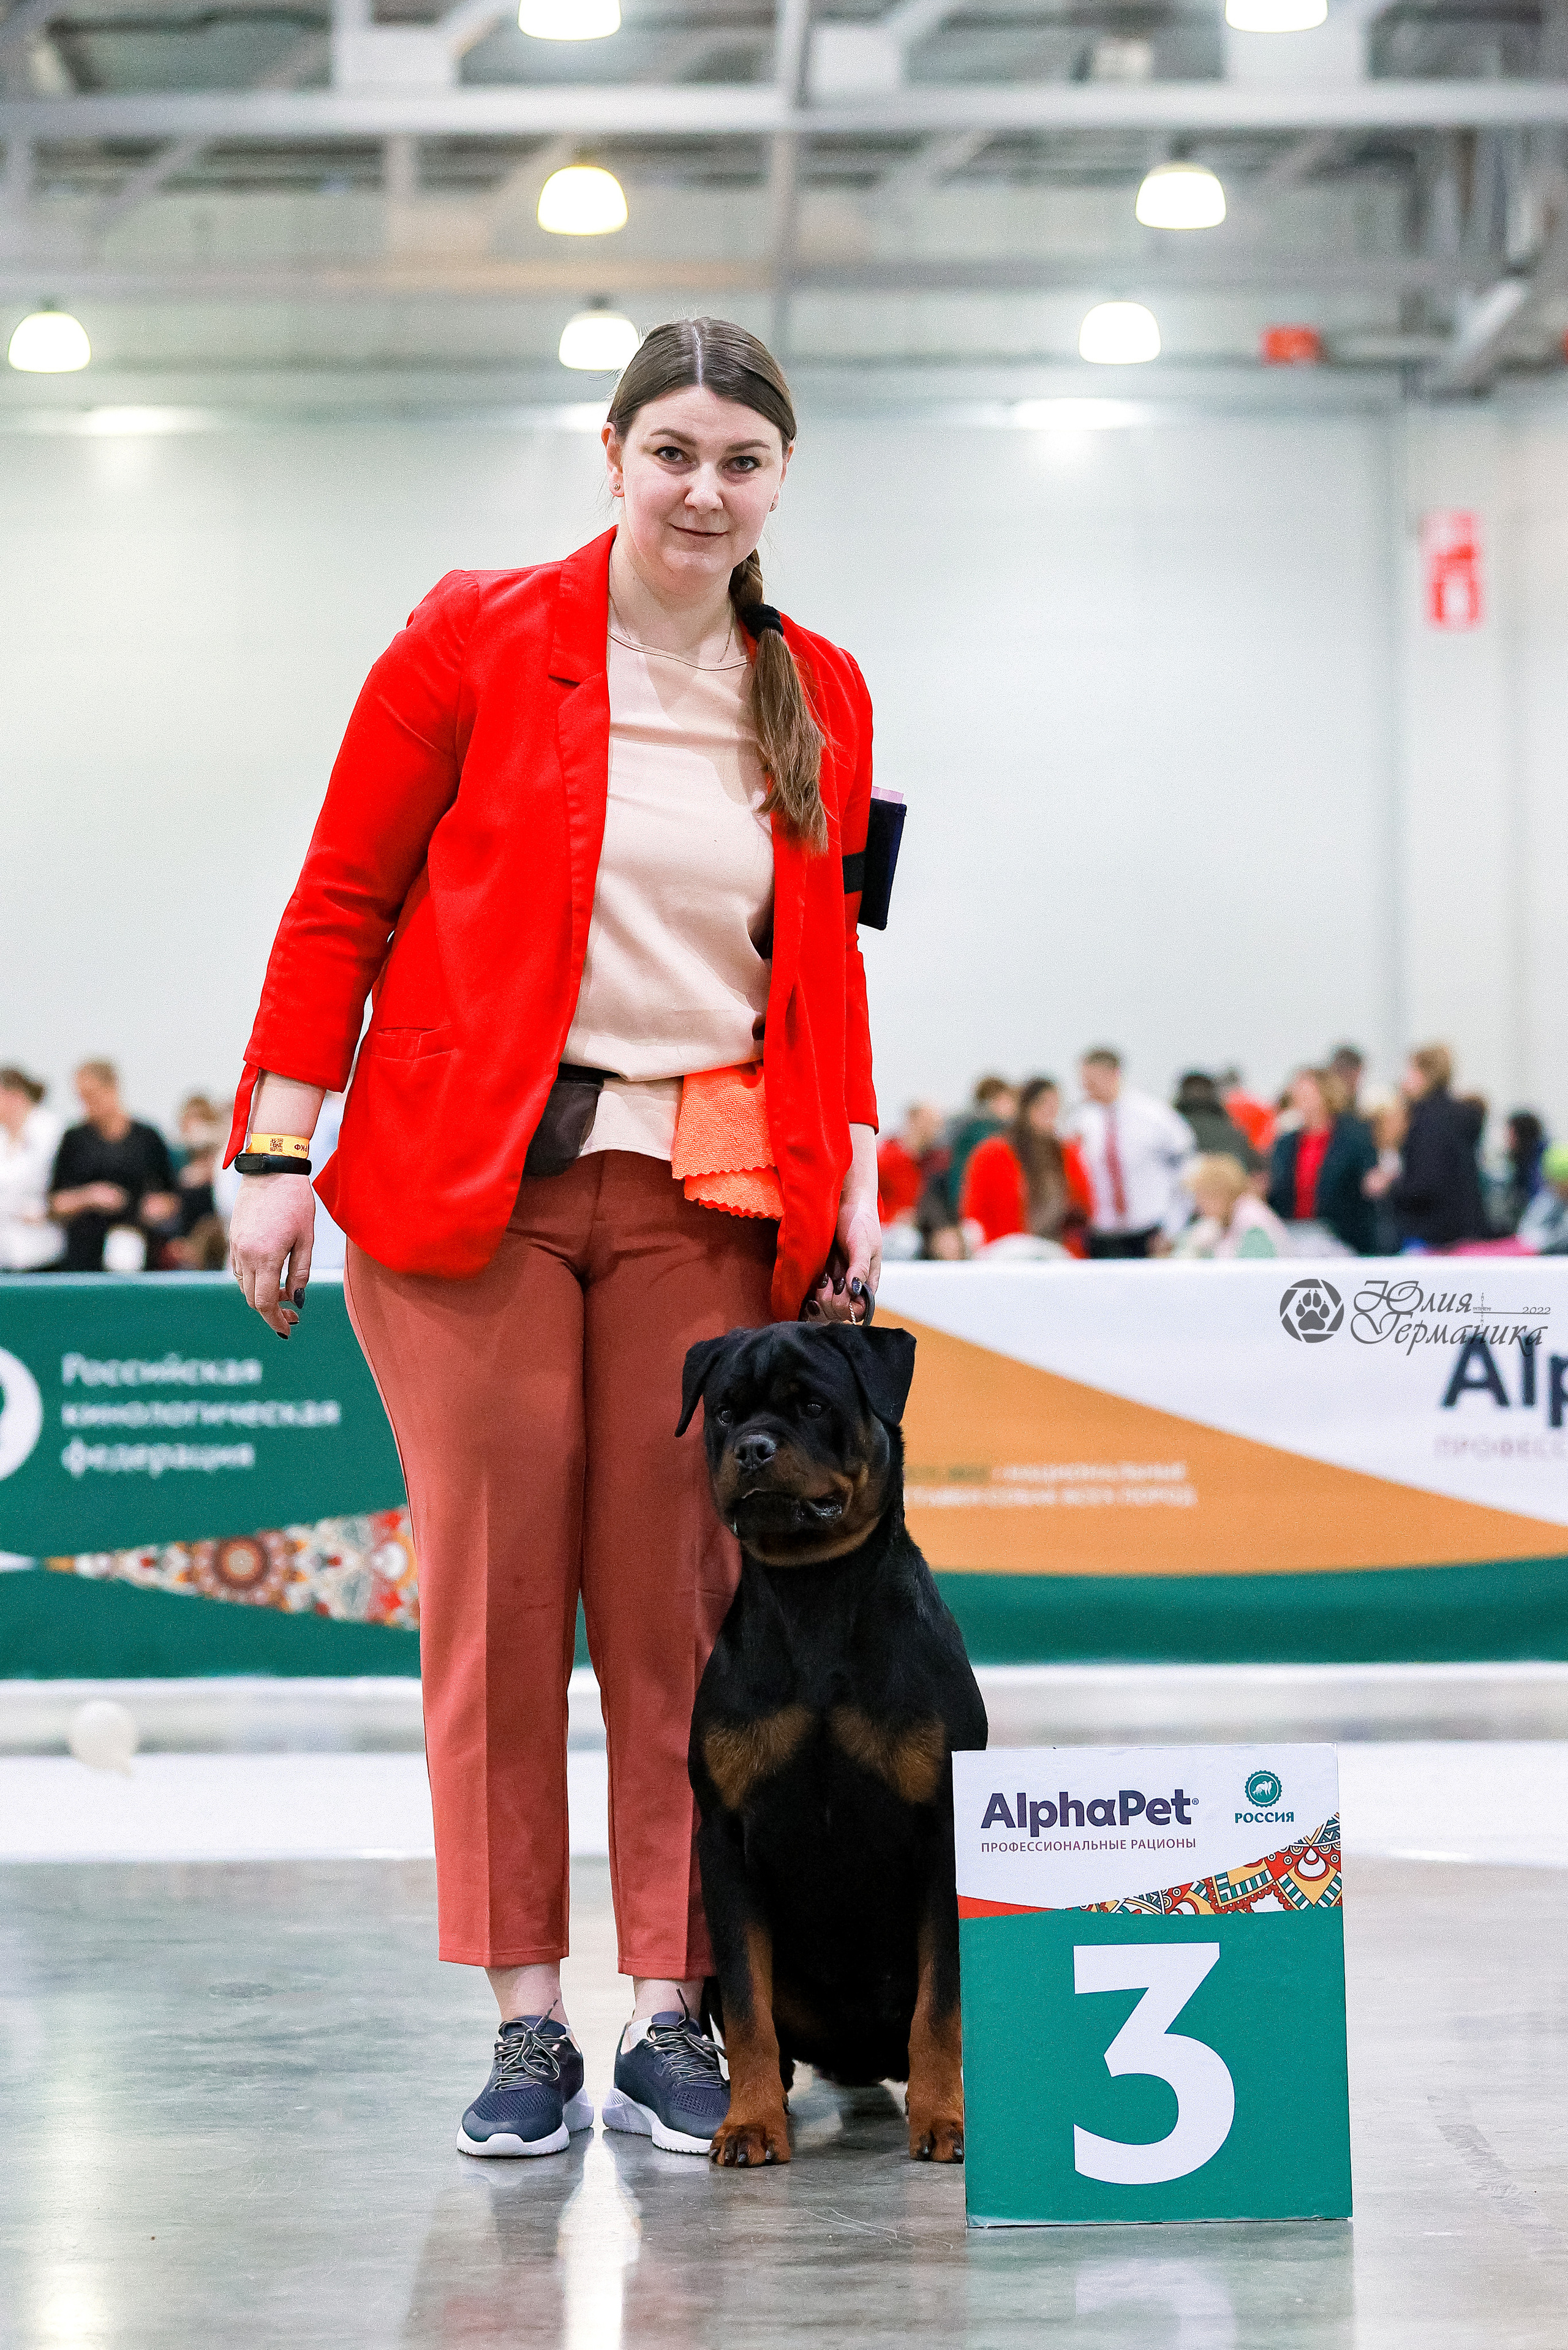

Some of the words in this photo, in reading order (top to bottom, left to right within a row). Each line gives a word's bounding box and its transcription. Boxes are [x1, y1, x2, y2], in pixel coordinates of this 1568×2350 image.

[1235, 1811, 1295, 1824] РОССИЯ
[981, 1839, 1126, 1853] ПРОФЕССИОНАЛЬНЫЕ
[1131, 1838, 1196, 1850] РАЦИОНЫ
[1073, 1942, 1236, 2185] 3
